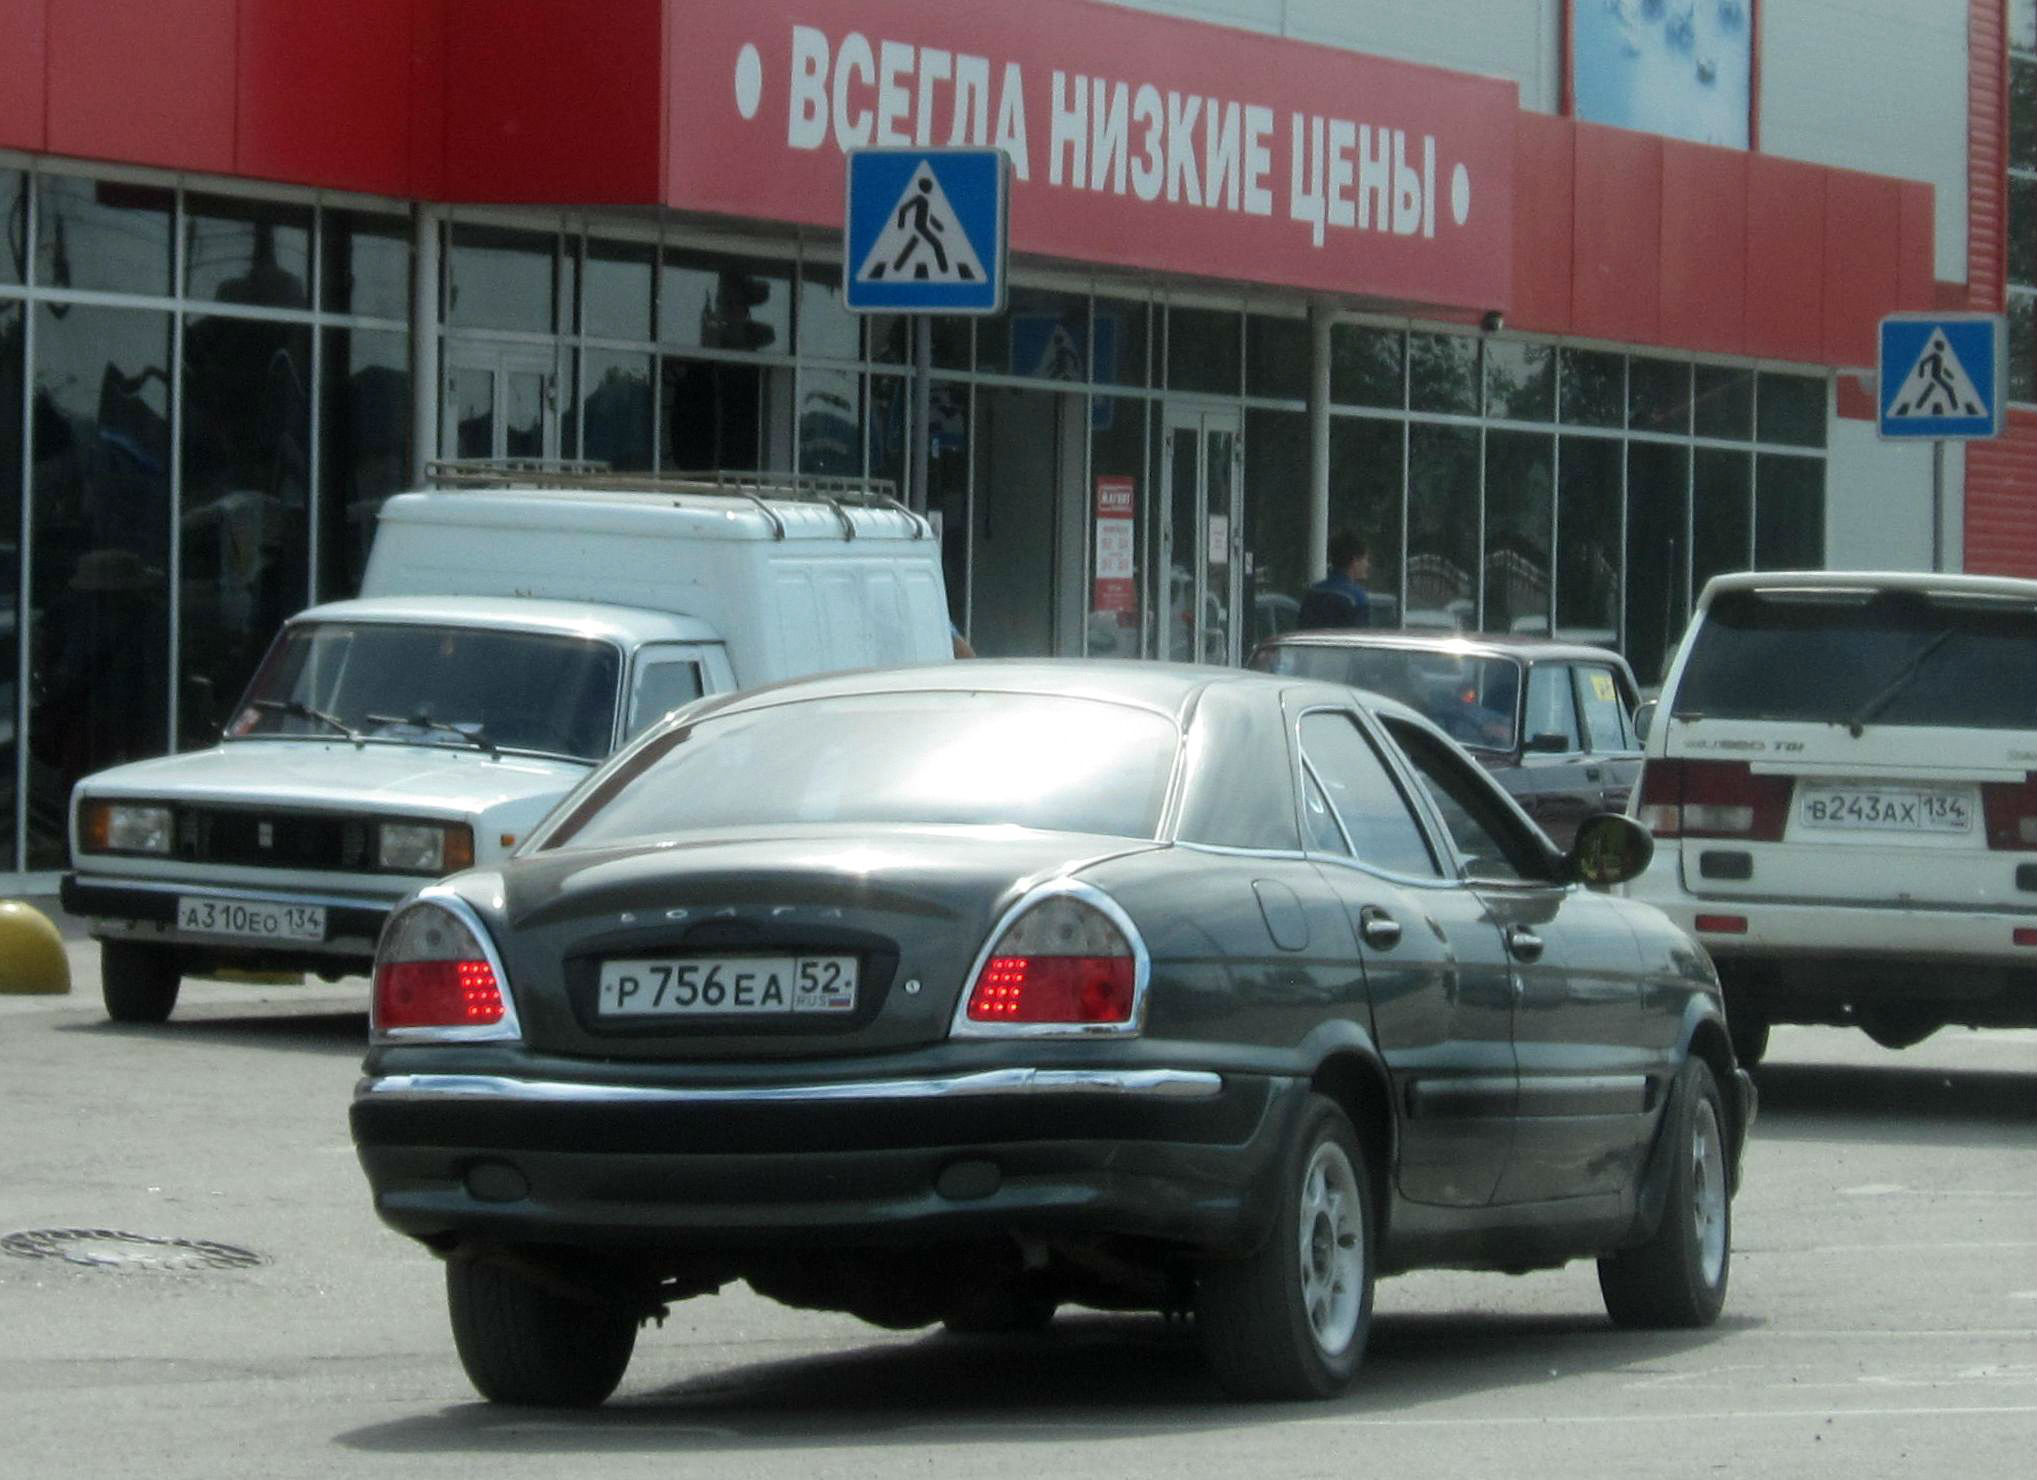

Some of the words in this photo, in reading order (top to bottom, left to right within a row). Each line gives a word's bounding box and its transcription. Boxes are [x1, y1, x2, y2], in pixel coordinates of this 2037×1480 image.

[1049, 69, 1273, 216] НИЗКИЕ
[1290, 112, 1436, 248] ЦЕНЫ
[1923, 797, 1962, 819] 134
[284, 908, 320, 930] 134
[800, 961, 842, 994] 52
